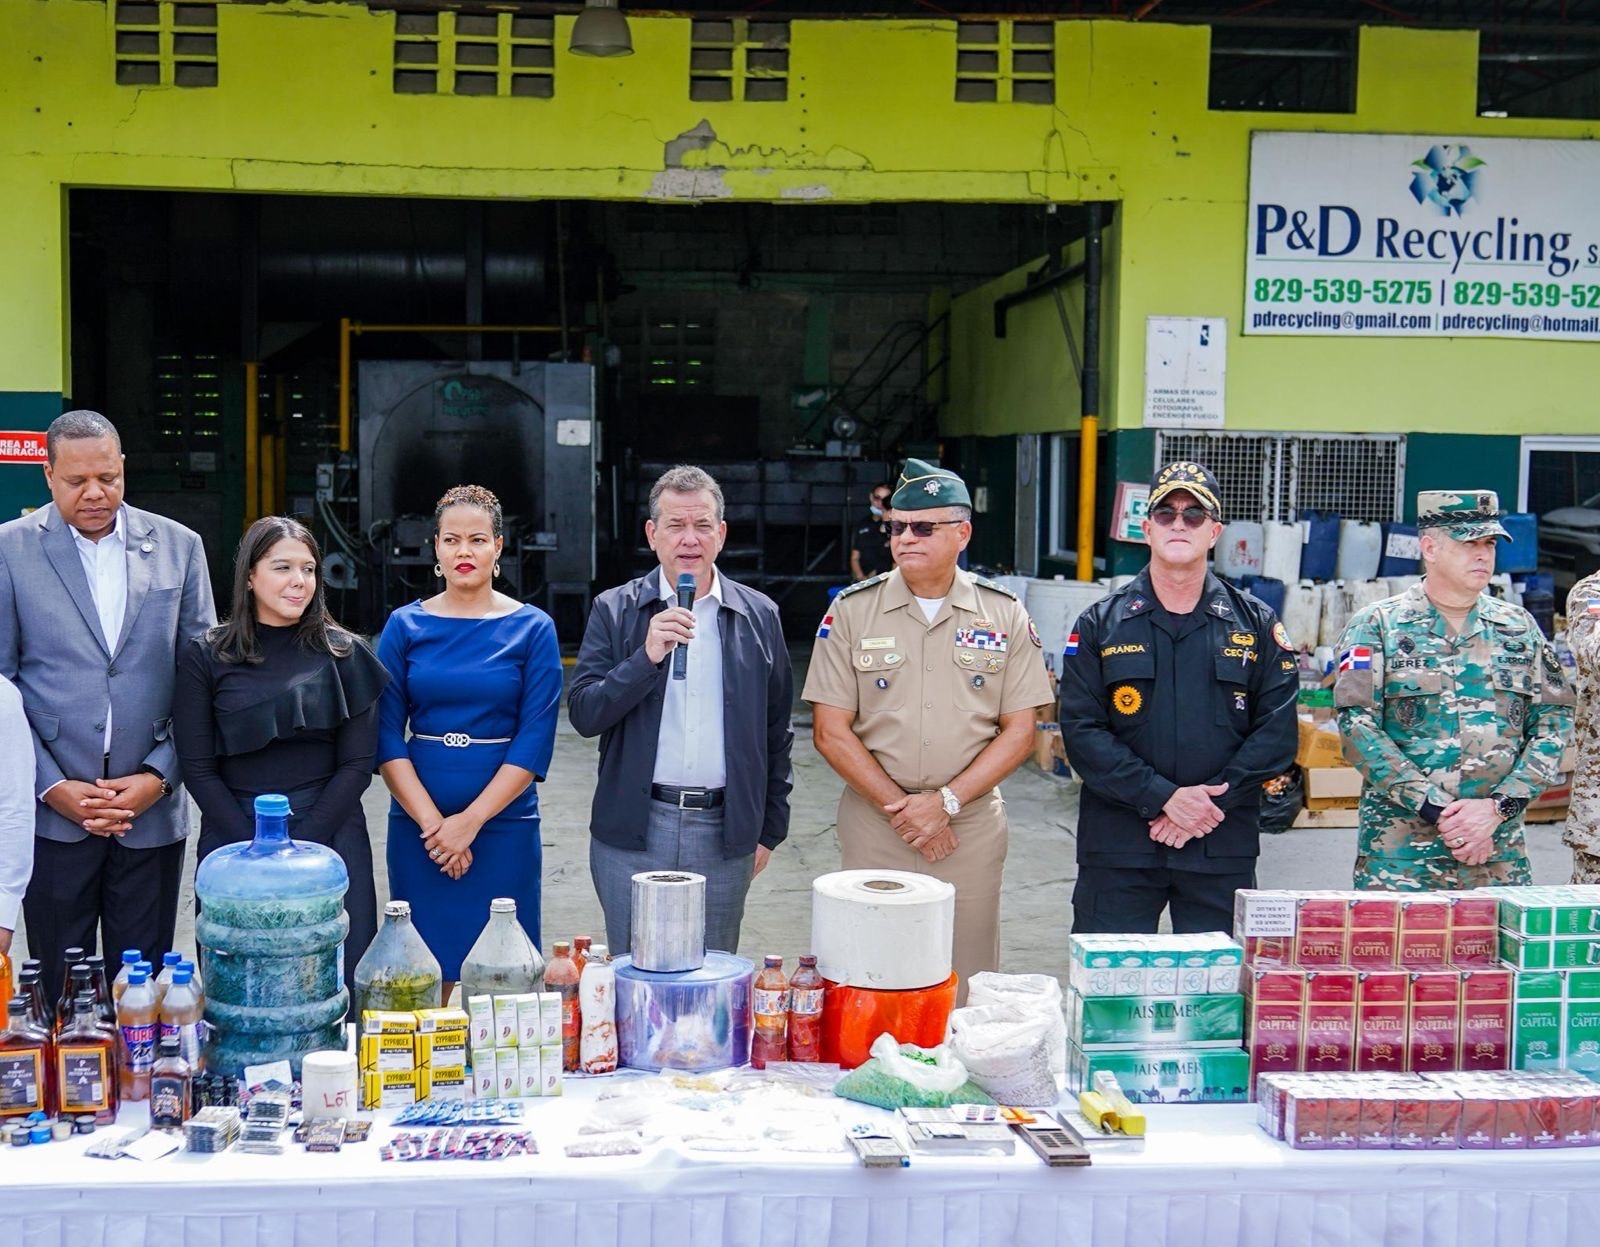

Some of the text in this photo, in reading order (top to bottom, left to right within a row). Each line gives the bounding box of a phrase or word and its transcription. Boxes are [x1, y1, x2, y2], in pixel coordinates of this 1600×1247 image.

[1256, 204, 1361, 256] P&D
[1376, 217, 1580, 277] Recycling,
[1254, 278, 1432, 305] 829-539-5275
[1253, 311, 1431, 330] pdrecycling@gmail.com
[23, 440, 38, 449] DE
[1158, 462, 1207, 484] CECCOM
[1101, 644, 1145, 657] MIRANDA
[1391, 659, 1430, 669] JEREZ
[1302, 946, 1339, 956] CAPITAL
[1353, 946, 1390, 956] CAPITAL
[1404, 948, 1441, 958] CAPITAL
[1455, 944, 1491, 955] CAPITAL
[1128, 1004, 1202, 1020] JAISALMER
[1259, 1020, 1297, 1030] CAPITAL
[1311, 1020, 1349, 1030] CAPITAL
[1363, 1020, 1401, 1030] CAPITAL
[1416, 1020, 1453, 1030] CAPITAL
[1467, 1019, 1504, 1029] CAPITAL
[1520, 1017, 1557, 1028] CAPITAL
[383, 1038, 409, 1046] CYPRODEX
[435, 1035, 460, 1044] CYPRODEX
[386, 1073, 411, 1082] CYPRODEX
[435, 1070, 460, 1079] CYPRODEX
